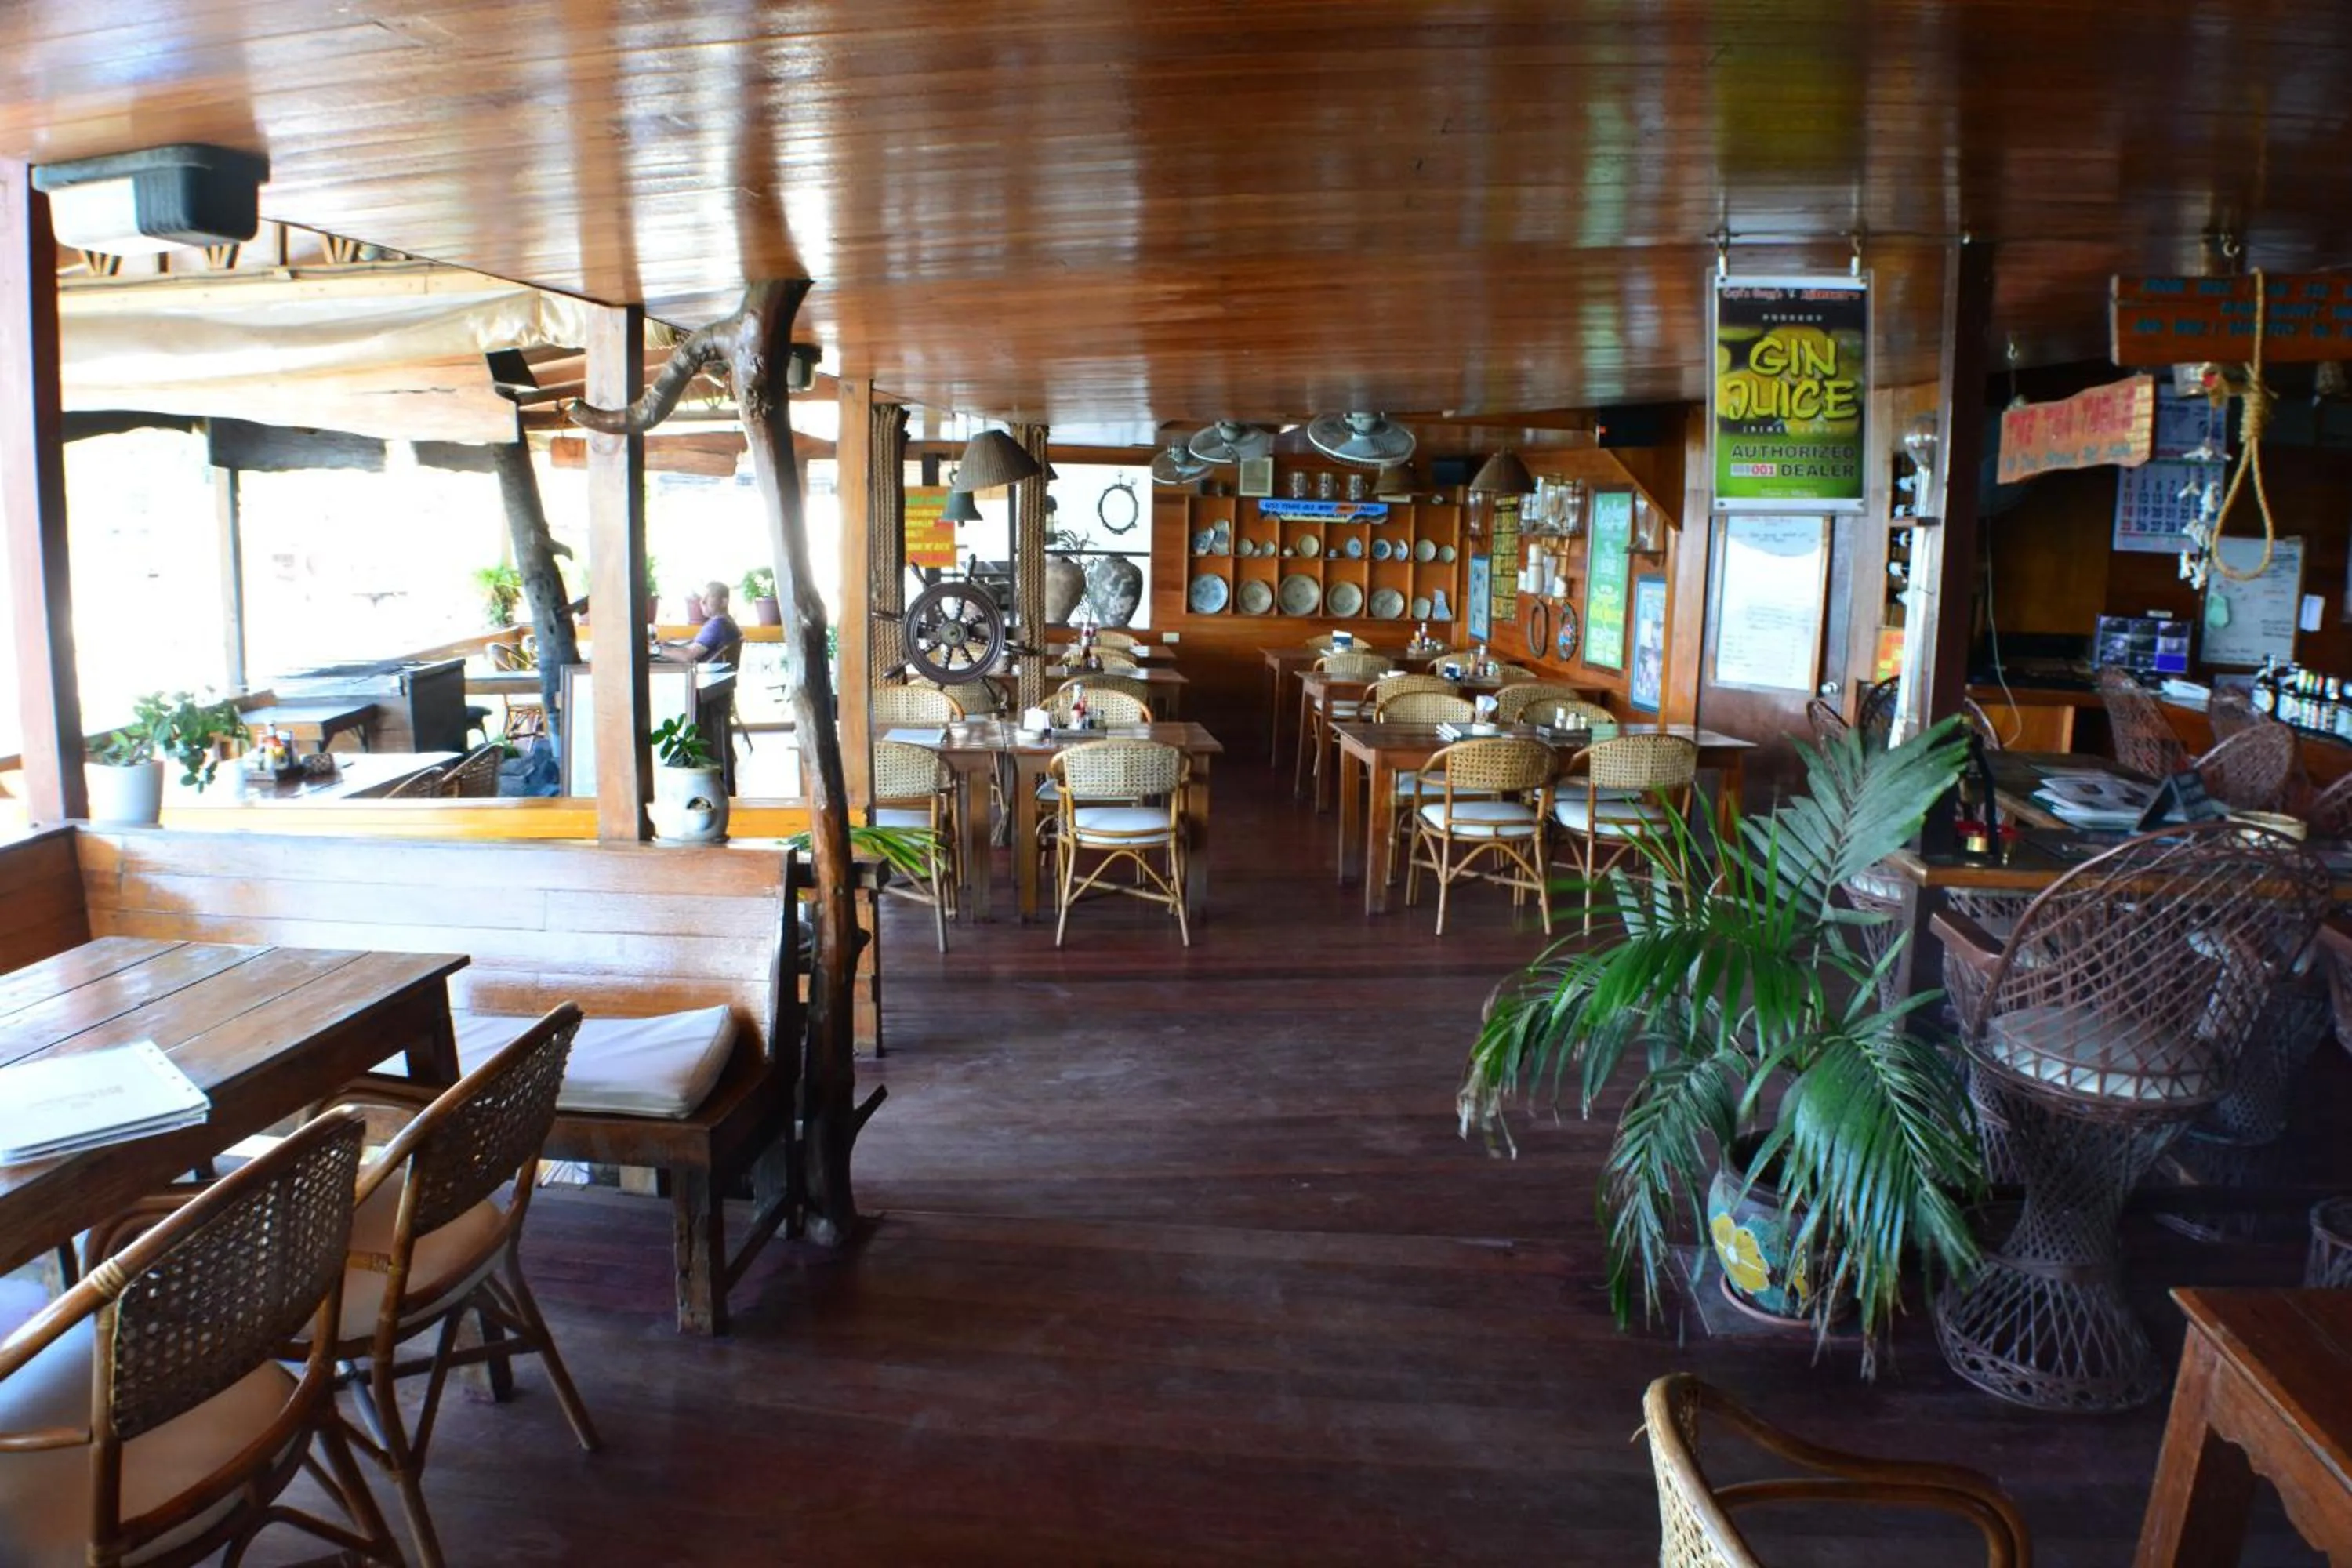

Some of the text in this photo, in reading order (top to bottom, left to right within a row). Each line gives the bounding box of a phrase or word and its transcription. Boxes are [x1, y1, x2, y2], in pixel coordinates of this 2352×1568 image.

[1749, 337, 1837, 378] GIN
[1728, 379, 1857, 421] JUICE
[1731, 445, 1855, 459] AUTHORIZED
[1780, 463, 1855, 477] DEALER
